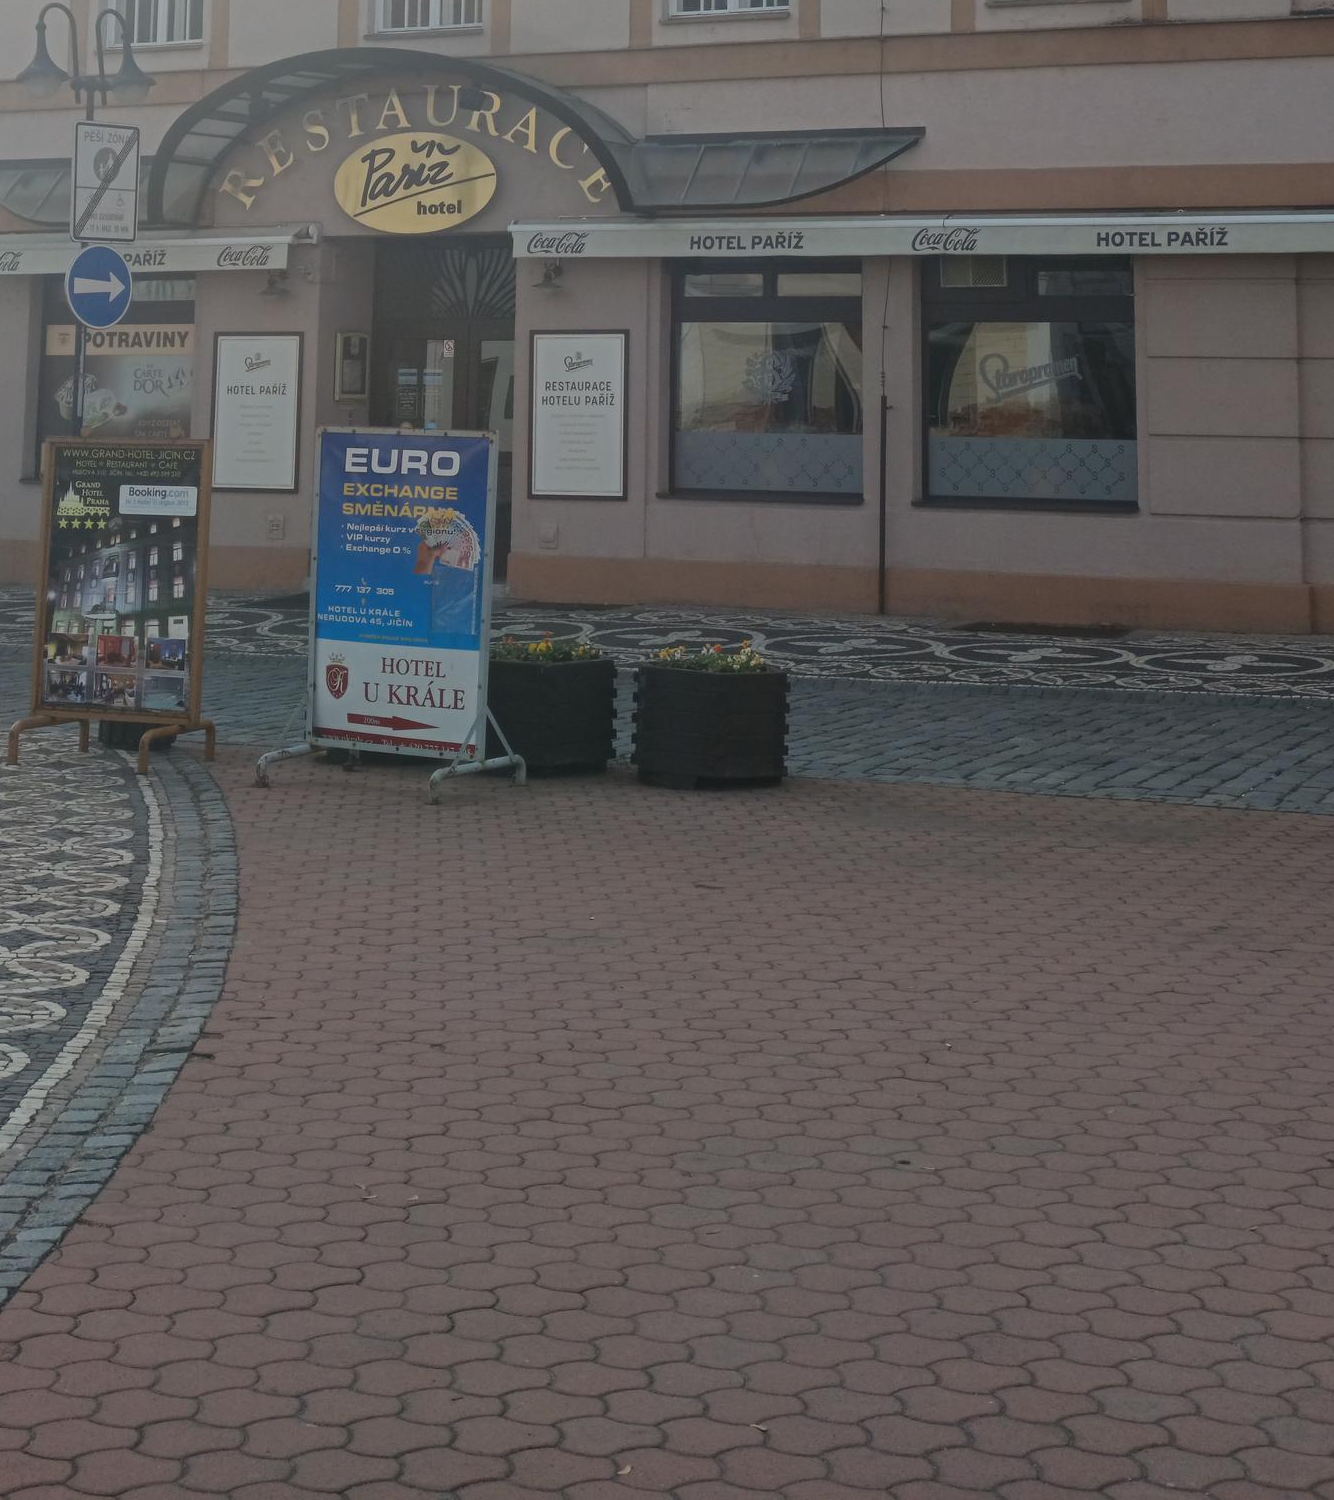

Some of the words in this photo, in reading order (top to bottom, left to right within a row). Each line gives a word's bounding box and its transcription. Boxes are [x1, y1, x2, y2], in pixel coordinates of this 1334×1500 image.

[218, 83, 613, 212] RESTAURACE
[416, 200, 463, 217] hotel
[527, 232, 590, 254] Coca-Cola
[690, 235, 747, 251] HOTEL
[751, 230, 805, 250] PAŘÍŽ
[912, 227, 983, 252] Coca-Cola
[1096, 229, 1162, 248] HOTEL
[1167, 224, 1230, 247] PAŘÍŽ
[216, 245, 275, 268] Coca-Cola
[544, 380, 612, 392] RESTAURACE
[978, 352, 1084, 405] Staropramen
[226, 385, 256, 396] HOTEL
[259, 383, 288, 396] PAŘÍŽ
[541, 395, 580, 406] HOTELU
[584, 393, 616, 406] PAŘÍŽ
[106, 459, 148, 469] RESTAURANT
[344, 447, 461, 478] EURO
[75, 480, 101, 489] GRAND
[128, 486, 189, 500] Booking.com
[342, 482, 459, 501] EXCHANGE
[342, 500, 455, 519] SMĚNÁR
[346, 522, 384, 534] Nejlepší
[385, 523, 407, 534] kurz
[346, 533, 363, 542] VIP
[364, 534, 391, 545] kurzy
[346, 543, 391, 556] Exchange
[334, 584, 353, 593] 777
[375, 587, 395, 596] 305
[316, 612, 368, 625] NERUDOVA
[387, 617, 414, 628] JIČÍN
[328, 605, 358, 615] HOTEL
[359, 607, 368, 616] U
[368, 606, 401, 618] KRÁLE
[381, 656, 447, 679] HOTEL
[362, 681, 380, 703] U
[387, 680, 466, 711] KRÁLE
